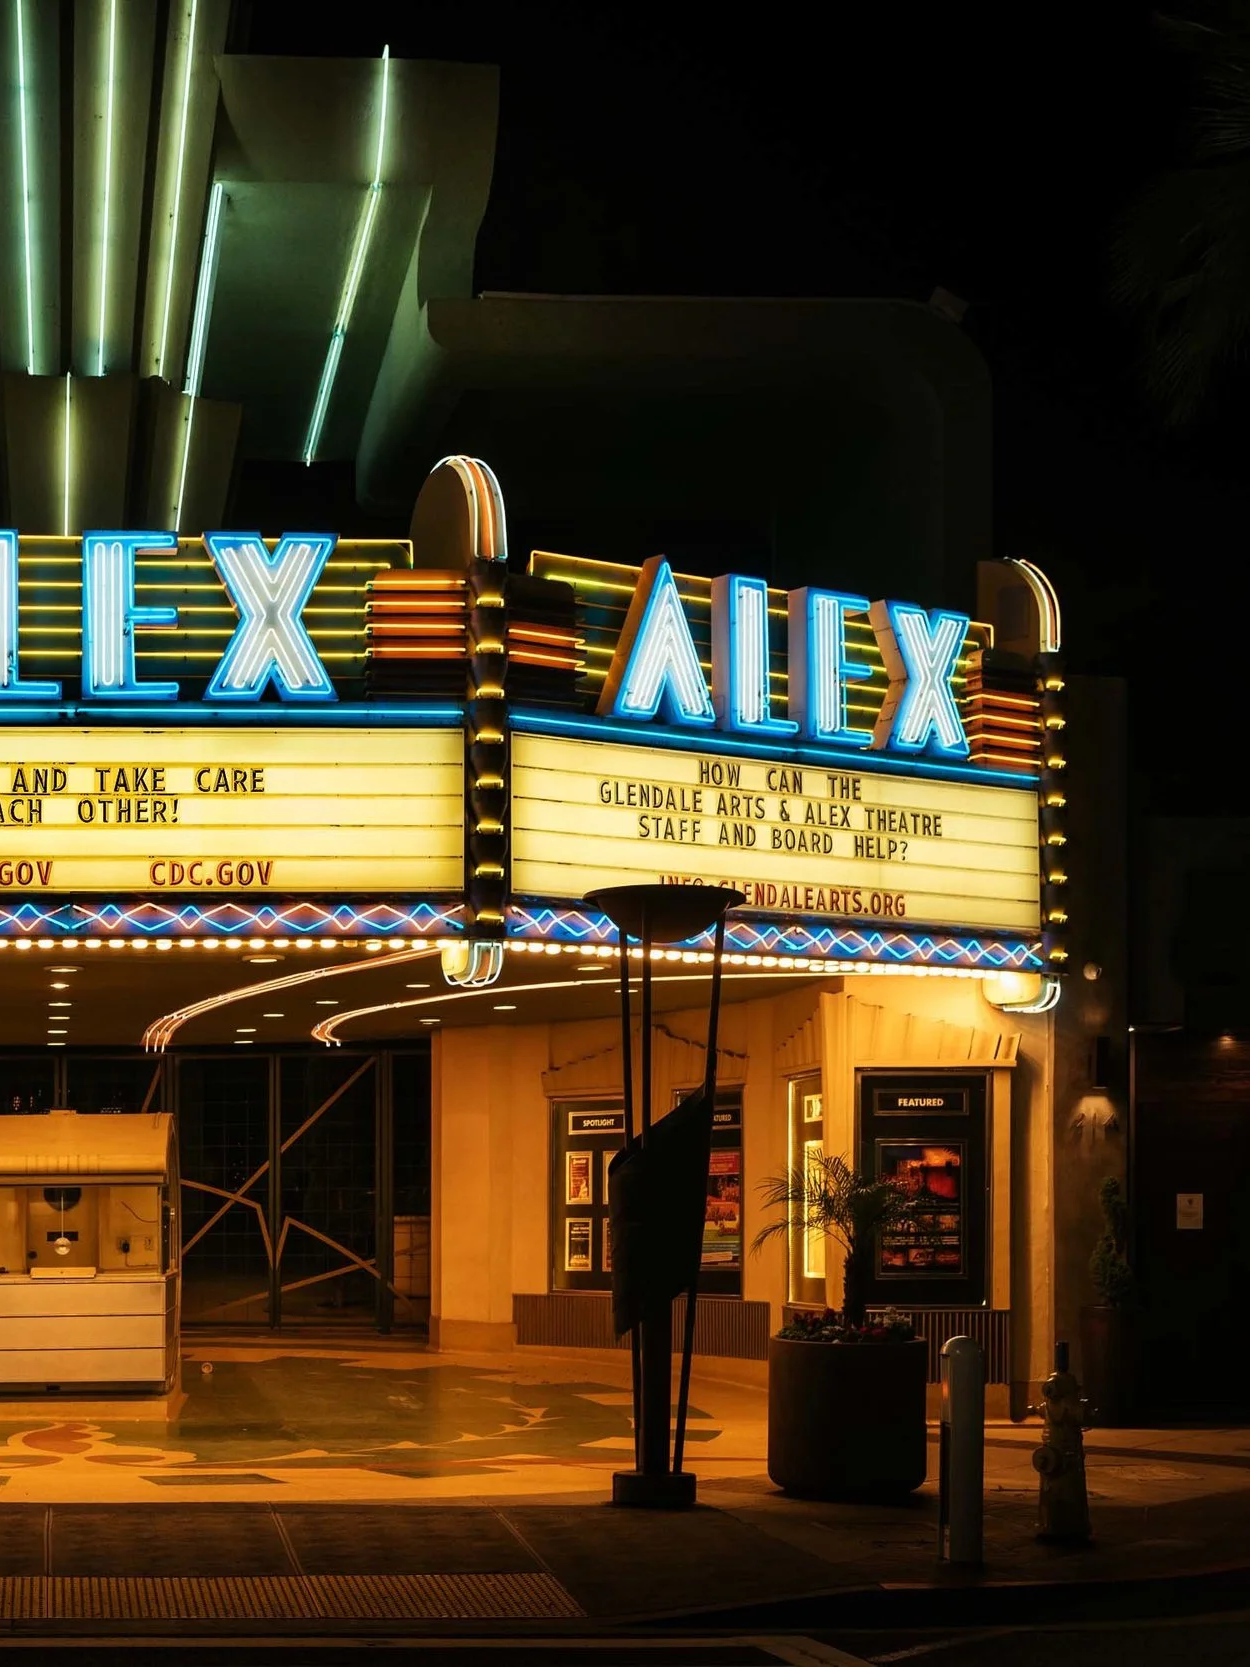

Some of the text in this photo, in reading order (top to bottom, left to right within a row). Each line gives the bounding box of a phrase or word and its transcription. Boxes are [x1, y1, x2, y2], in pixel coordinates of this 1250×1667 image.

[598, 554, 971, 760] ALEX
[11, 766, 68, 794] AND
[94, 766, 166, 794] TAKE
[195, 766, 266, 794] CARE
[698, 760, 862, 800] HOW CAN THE
[78, 798, 180, 824] OTHER!
[599, 781, 943, 838] GLENDALE ARTS & ALEX THEATRE
[638, 814, 909, 862] STAFF AND BOARD HELP?
[149, 860, 273, 888] CDC.GOV
[659, 874, 906, 917] ENDALEARTS.ORG
[897, 1097, 944, 1108] FEATURED
[582, 1118, 615, 1128] SPOTLIGHT
